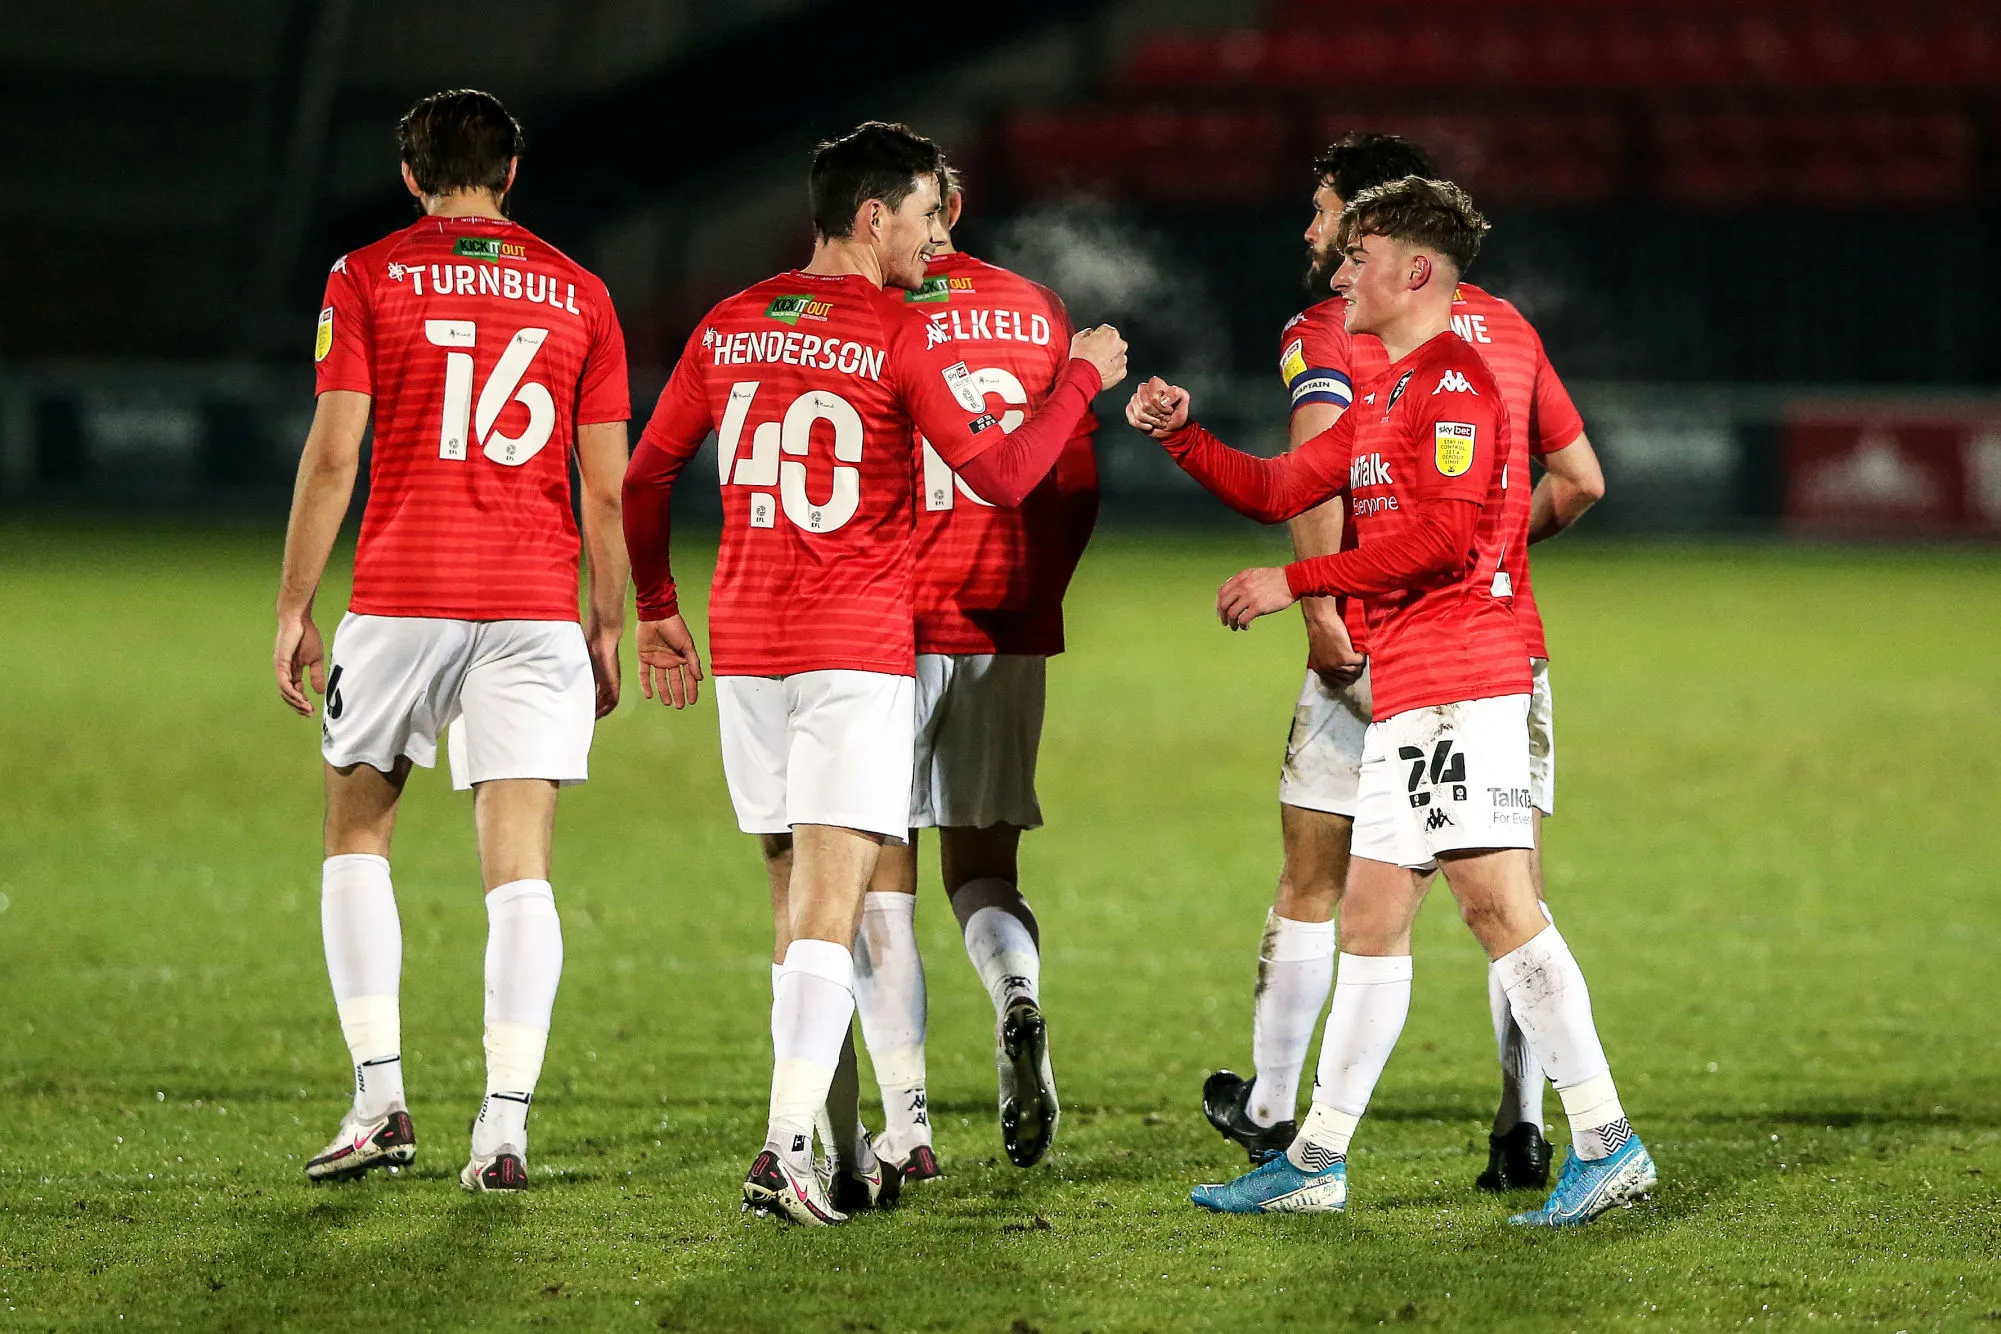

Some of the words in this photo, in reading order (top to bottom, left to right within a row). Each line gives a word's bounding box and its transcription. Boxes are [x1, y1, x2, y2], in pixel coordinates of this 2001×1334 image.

[460, 239, 489, 253] KICK
[502, 244, 526, 257] OUT
[405, 264, 580, 315] TURNBULL
[949, 278, 972, 289] OUT
[807, 301, 834, 317] OUT
[713, 331, 886, 381] HENDERSON
[425, 319, 556, 467] 16
[1438, 425, 1453, 435] sky
[1454, 425, 1472, 436] bet
[717, 380, 865, 534] 40
[1398, 740, 1467, 808] 24
[1493, 811, 1510, 824] For
